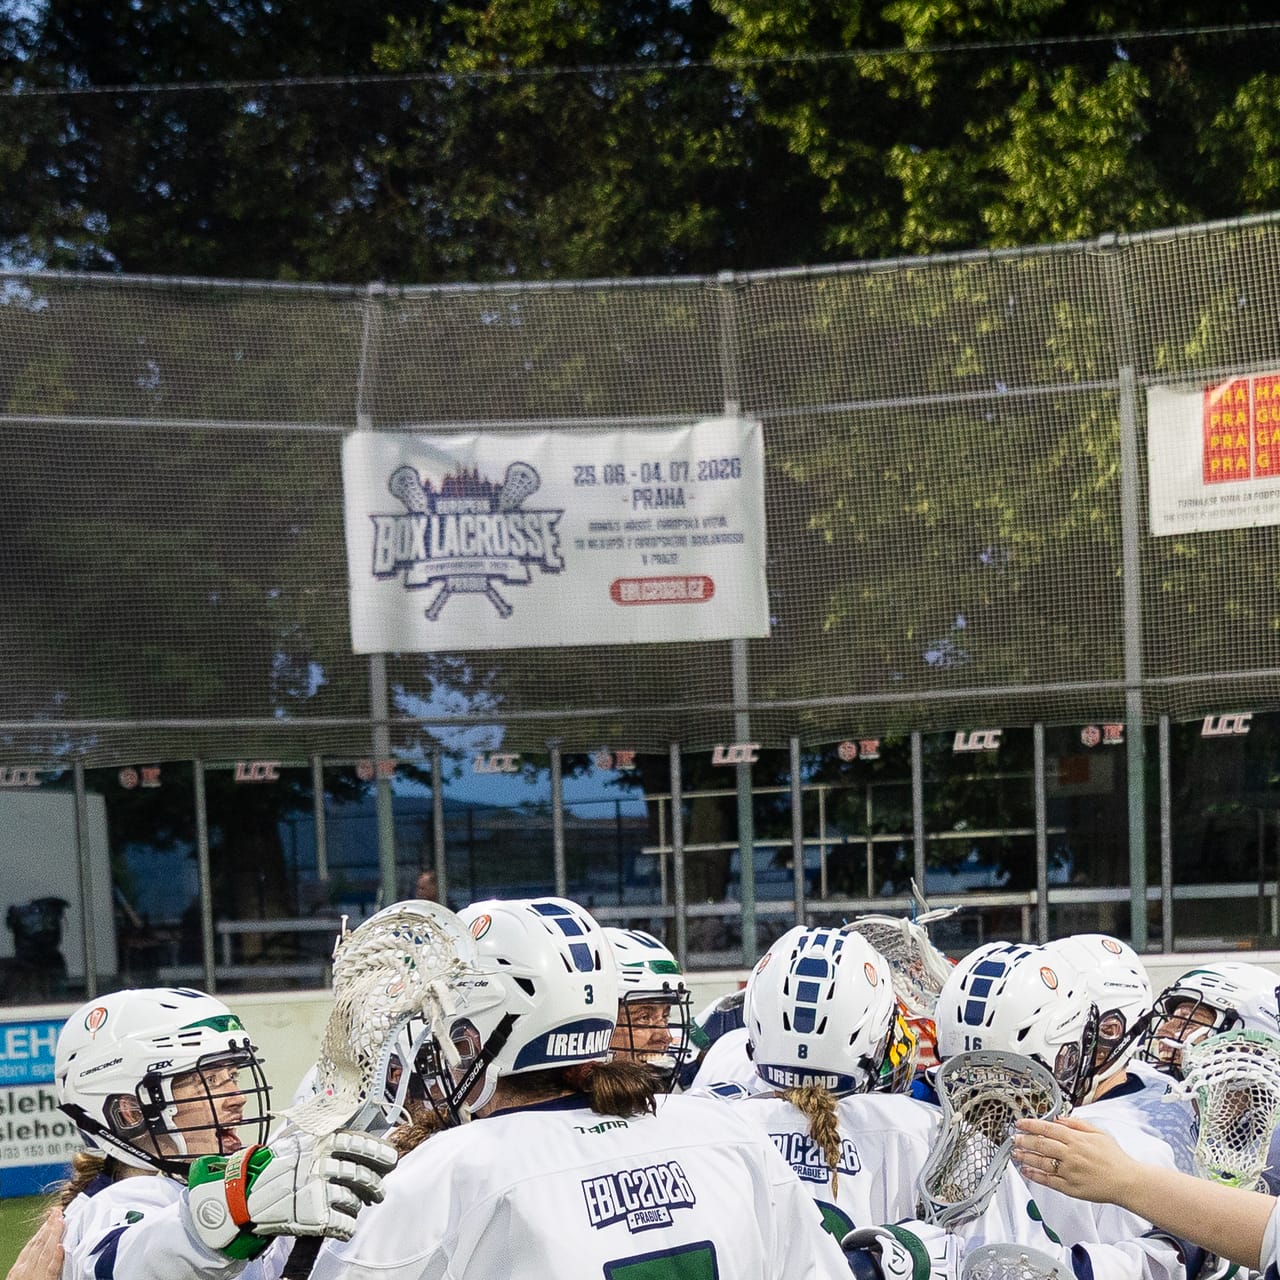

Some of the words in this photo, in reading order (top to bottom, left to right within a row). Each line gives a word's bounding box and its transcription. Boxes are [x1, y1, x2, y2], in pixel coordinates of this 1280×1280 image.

[1210, 411, 1246, 429] PRA
[1210, 433, 1246, 450] PRA
[698, 458, 742, 481] 2026
[1210, 456, 1247, 473] PRA
[1257, 452, 1269, 469] G
[633, 487, 686, 511] PRAHA
[375, 516, 429, 573] BOX
[431, 513, 564, 570] LACROSSE
[1201, 714, 1253, 736] LCC
[953, 730, 1003, 752] LCC
[584, 984, 594, 1005] 3
[546, 1029, 612, 1057] IRELAND
[798, 1044, 808, 1059] 8
[964, 1036, 982, 1051] 16
[79, 1057, 123, 1078] cascade
[768, 1067, 839, 1089] IRELAND
[453, 1058, 485, 1106] cascade
[99, 1129, 152, 1162] cascade
[583, 1161, 696, 1229] EBLC2026
[634, 1208, 664, 1227] PRAGUE
